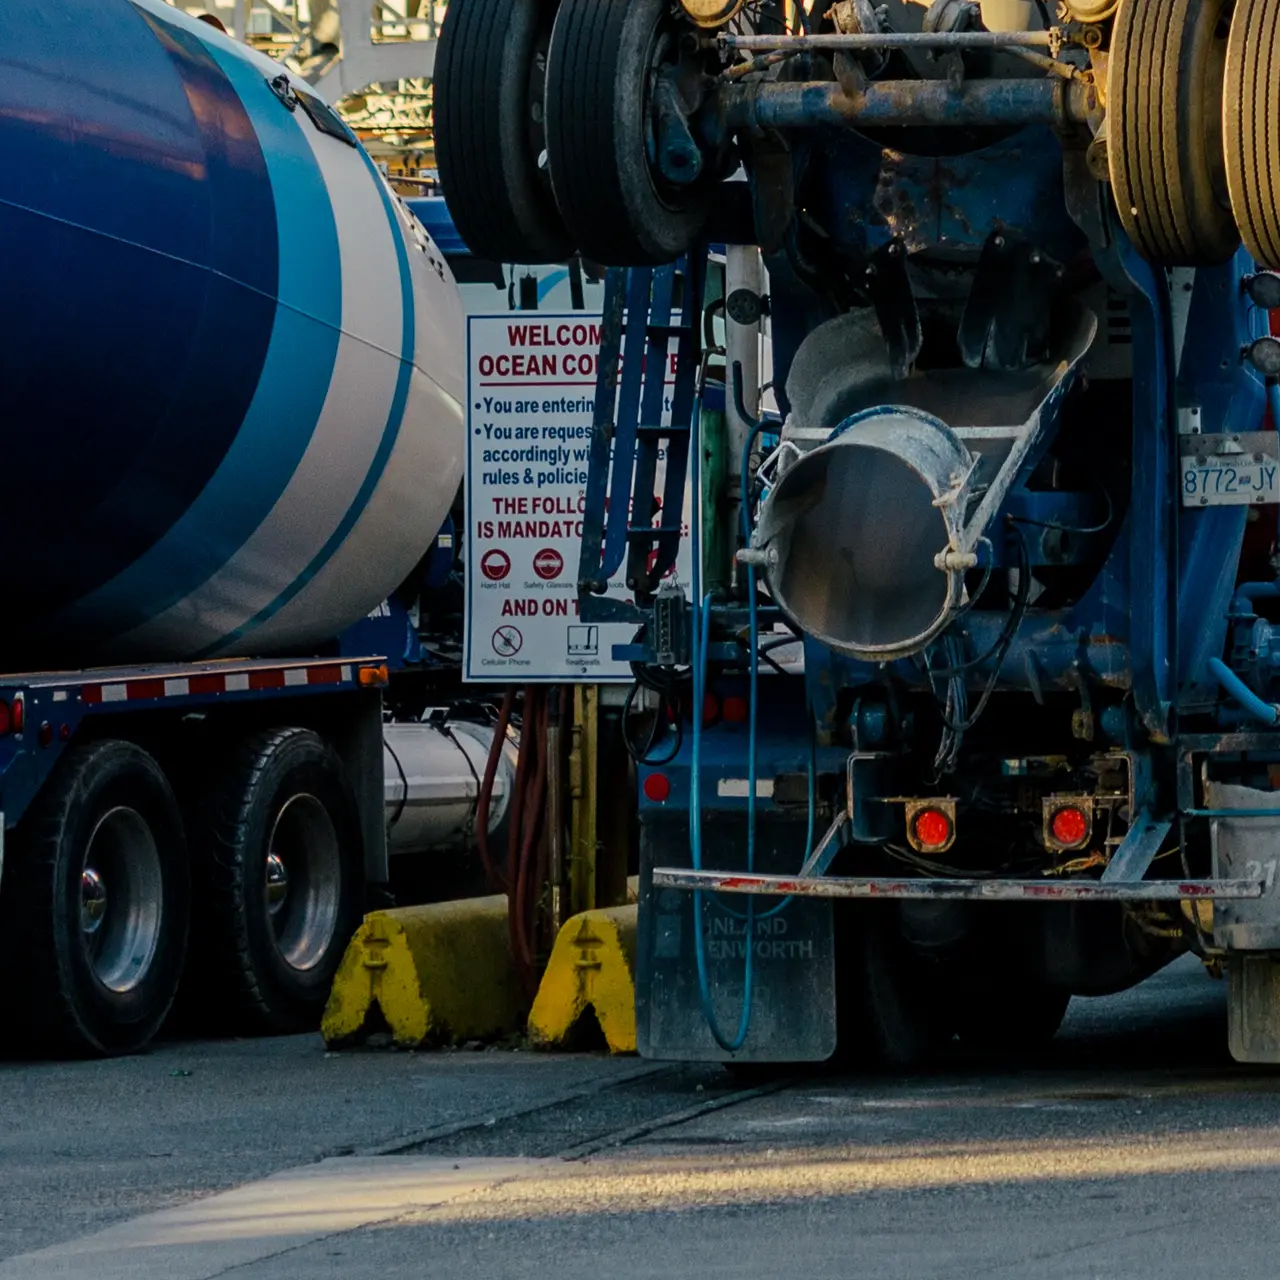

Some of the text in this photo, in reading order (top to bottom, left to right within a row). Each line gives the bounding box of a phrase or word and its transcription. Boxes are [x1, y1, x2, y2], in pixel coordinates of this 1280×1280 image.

[507, 324, 602, 347] WELCOM
[478, 354, 557, 377] OCEAN
[483, 397, 595, 414] You are enterin
[483, 423, 593, 445] You are reques
[482, 445, 570, 466] accordingly
[482, 468, 588, 488] rules & policie
[1184, 466, 1276, 494] 8772 JY
[492, 497, 528, 515] THE
[532, 496, 585, 515] FOLLO
[477, 521, 494, 539] IS
[498, 520, 583, 539] MANDATO
[501, 598, 538, 617] AND
[542, 598, 568, 617] ON
[508, 657, 531, 666] Phone
